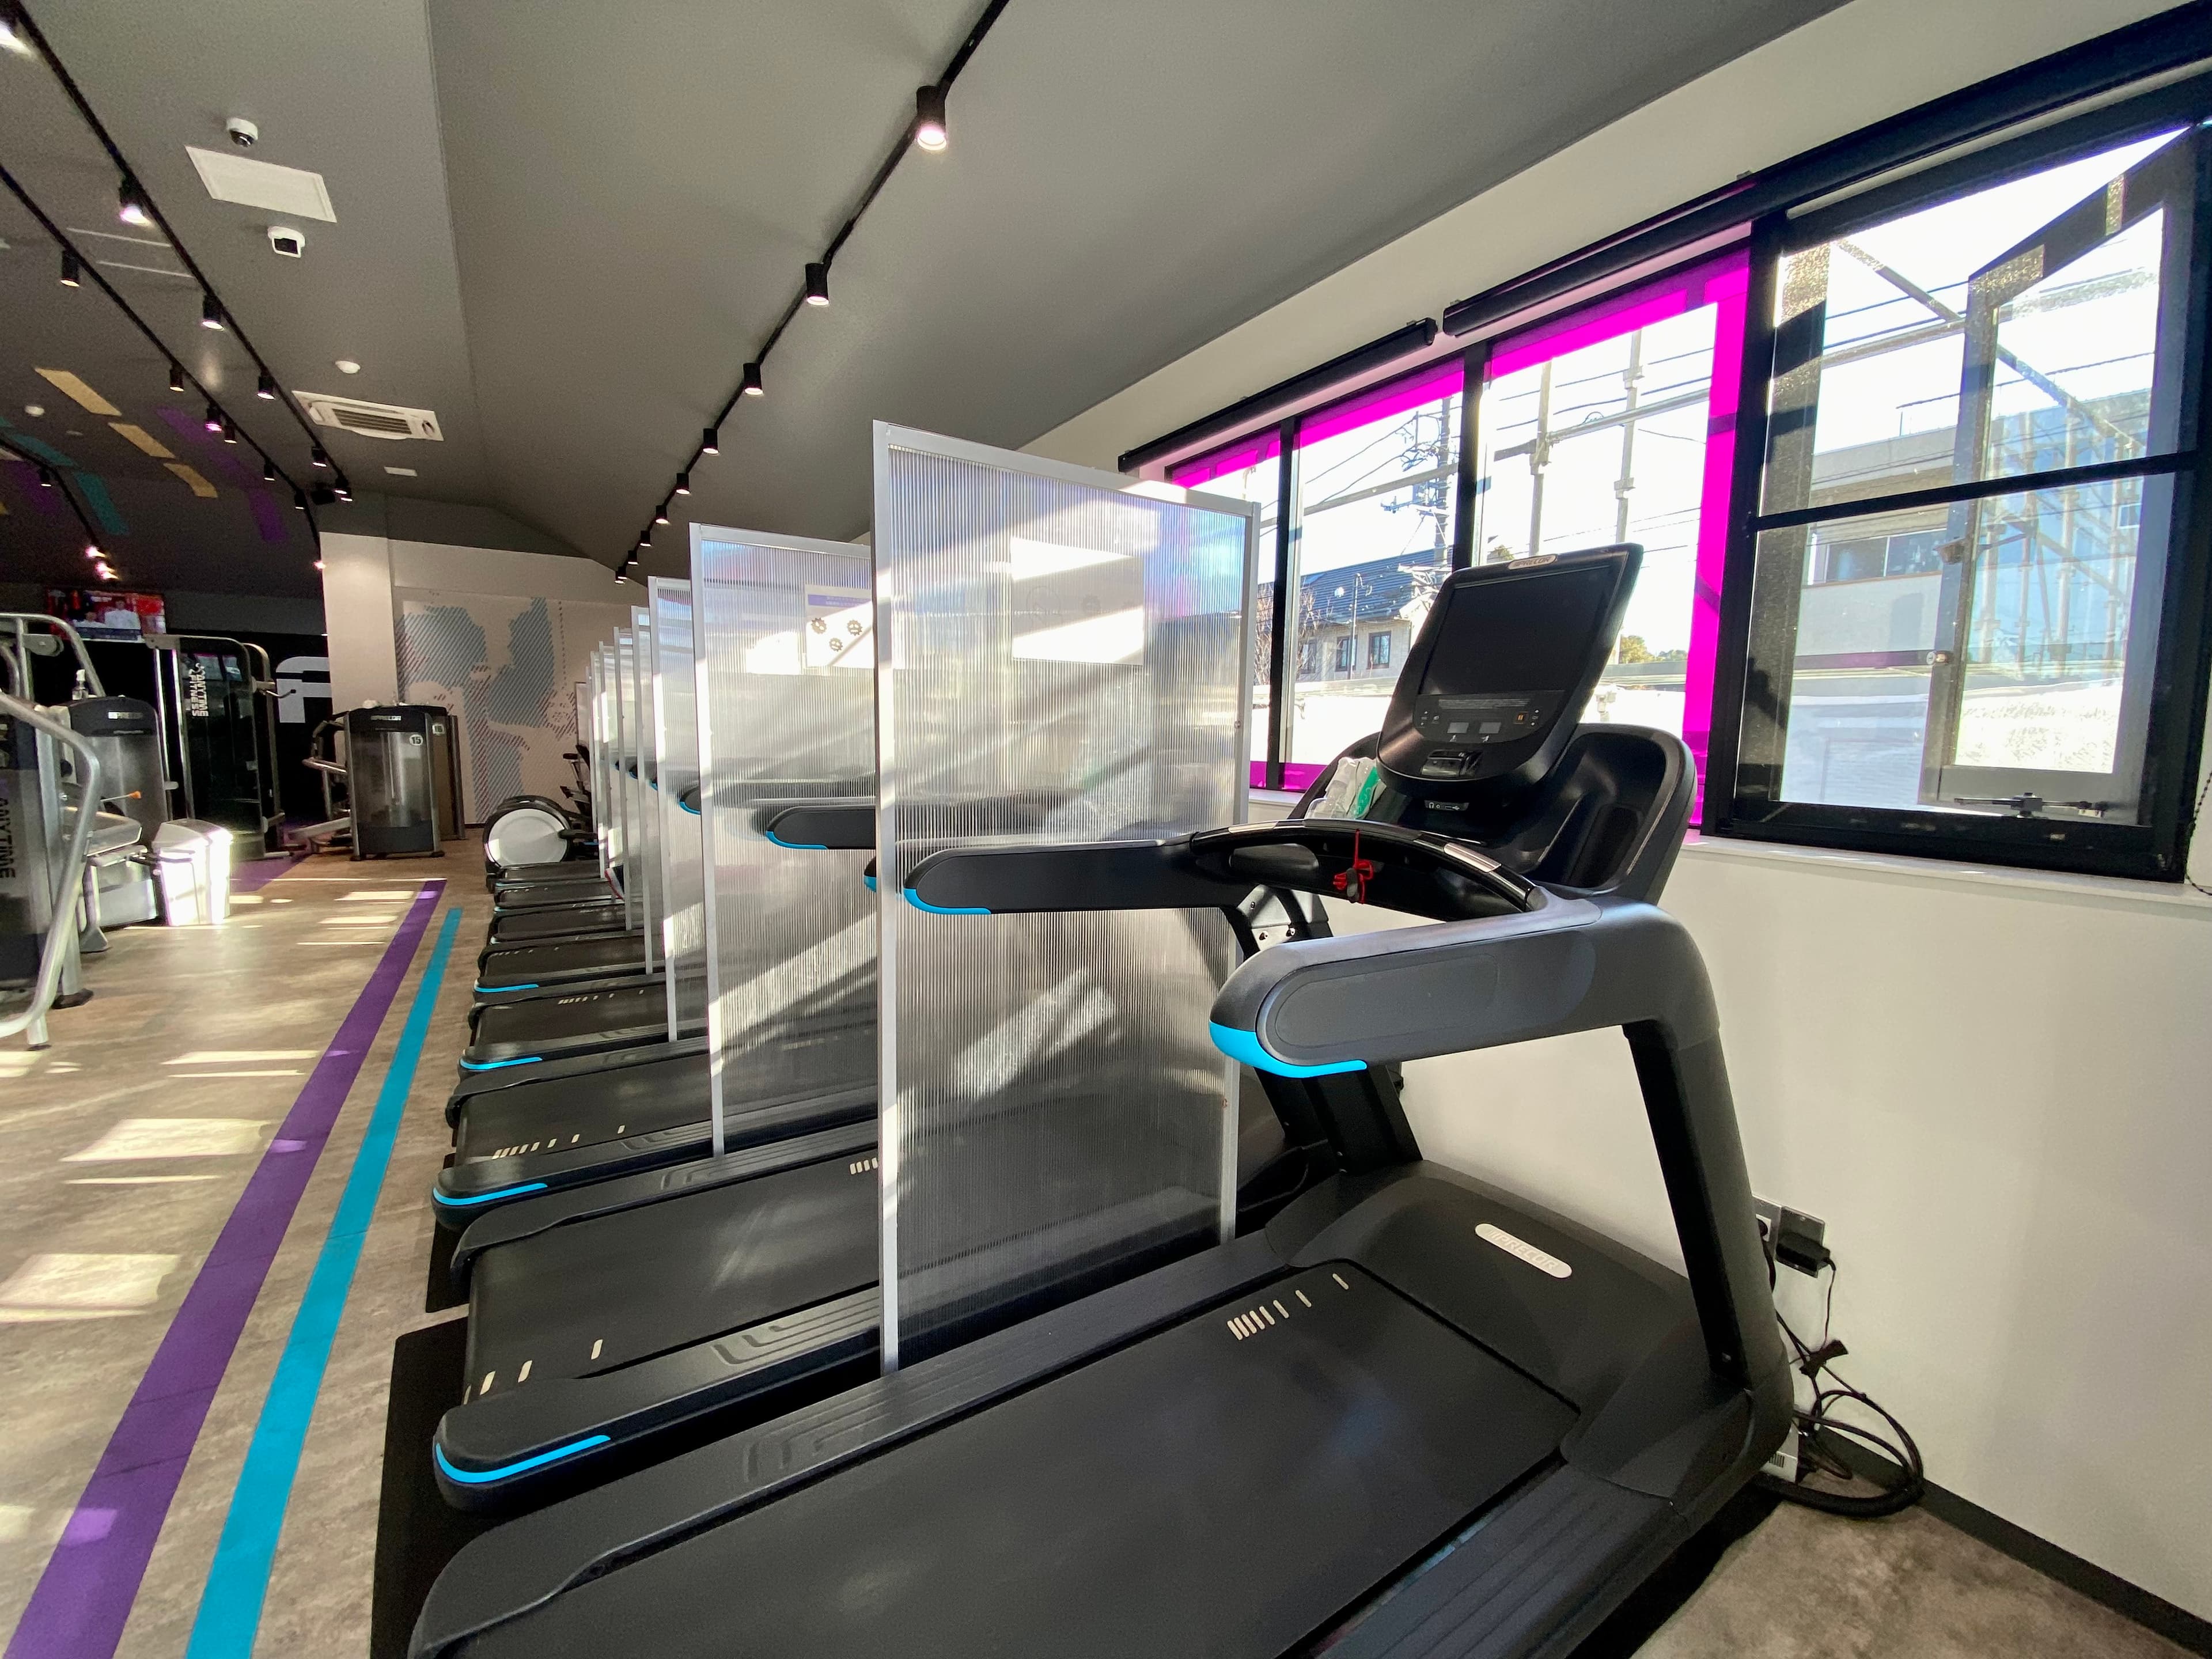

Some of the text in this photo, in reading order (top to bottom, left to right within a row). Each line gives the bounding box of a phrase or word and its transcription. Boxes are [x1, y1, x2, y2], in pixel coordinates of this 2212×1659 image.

[188, 675, 199, 716] FITNESS
[196, 675, 209, 716] ANYTIME
[1497, 1234, 1559, 1270] PRECOR
